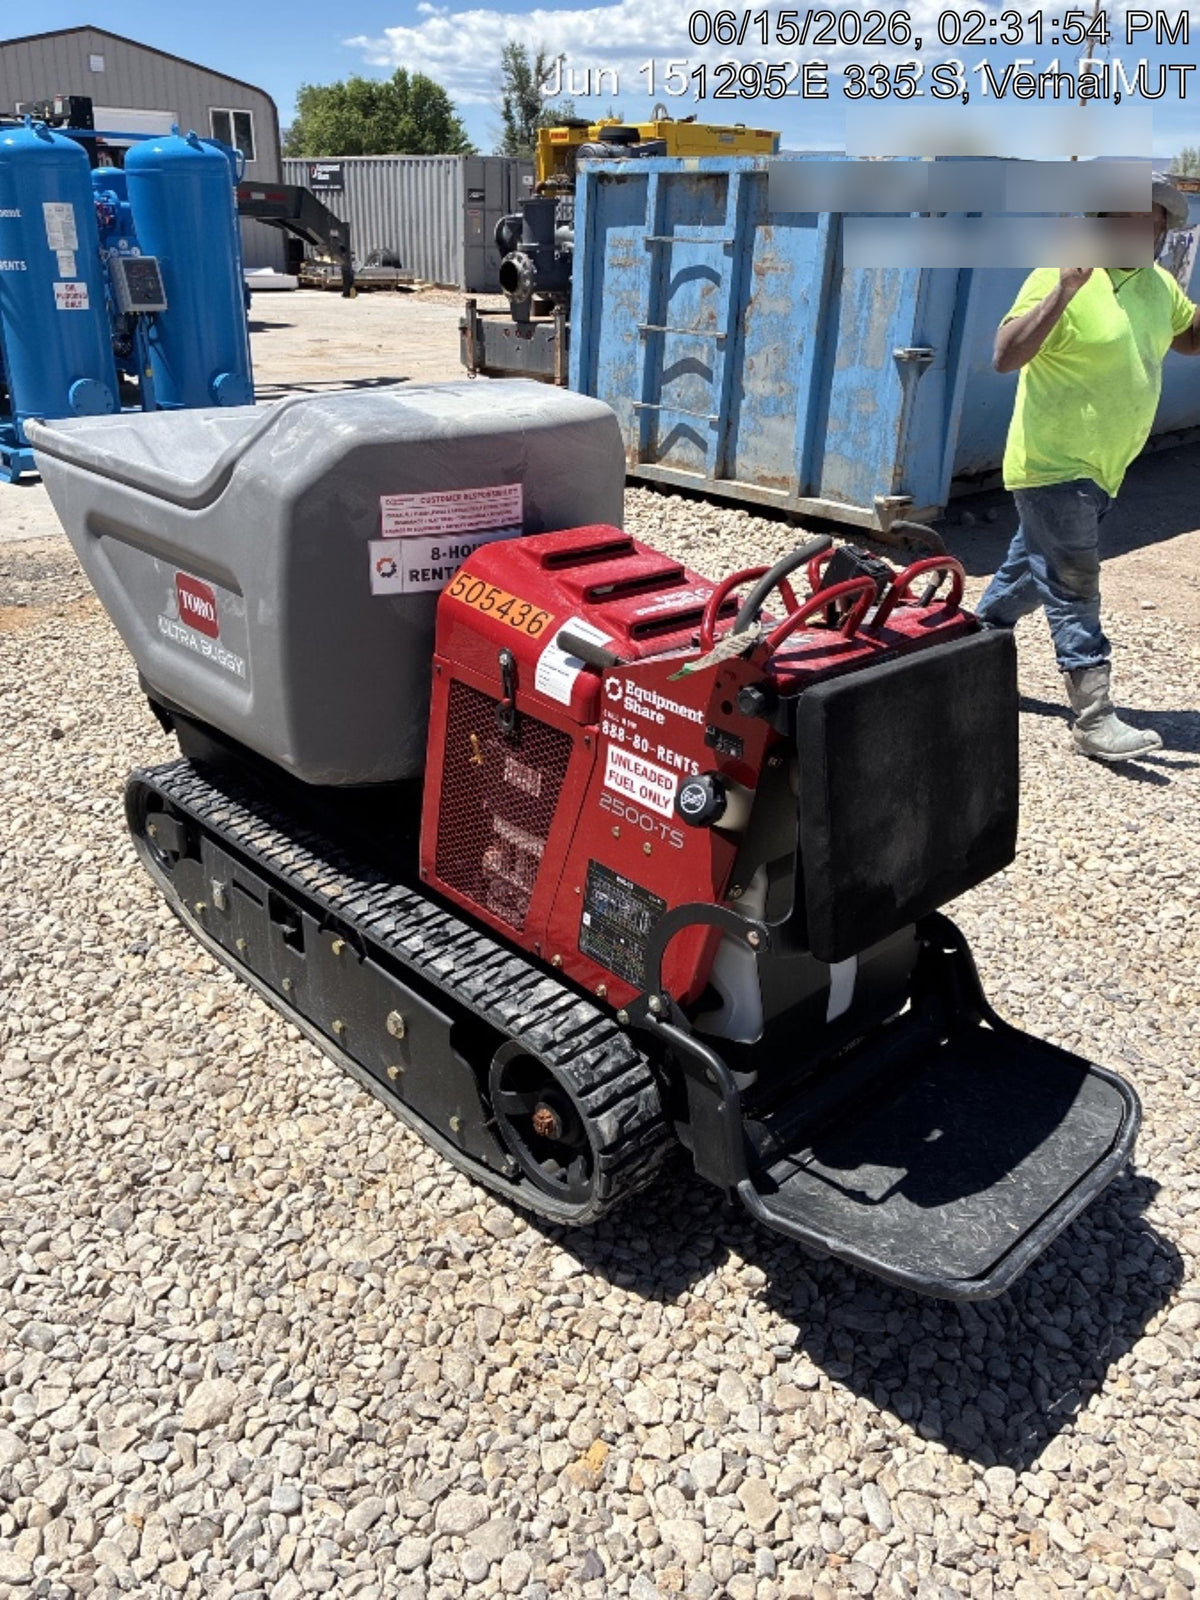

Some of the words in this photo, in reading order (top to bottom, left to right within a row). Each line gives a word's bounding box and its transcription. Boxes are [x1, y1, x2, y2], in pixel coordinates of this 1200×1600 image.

[431, 543, 491, 561] 8-HO
[179, 589, 216, 623] TORO
[450, 573, 549, 635] 505436
[157, 614, 199, 650] ULTRA
[200, 639, 244, 675] BUGGY
[624, 696, 666, 726] Share
[625, 679, 704, 725] Equipment
[602, 719, 700, 776] 888-80-RENTS
[608, 769, 637, 793] FUEL
[639, 785, 671, 810] ONLY
[611, 750, 673, 791] UNLEADED
[599, 791, 685, 849] 2500-TS
